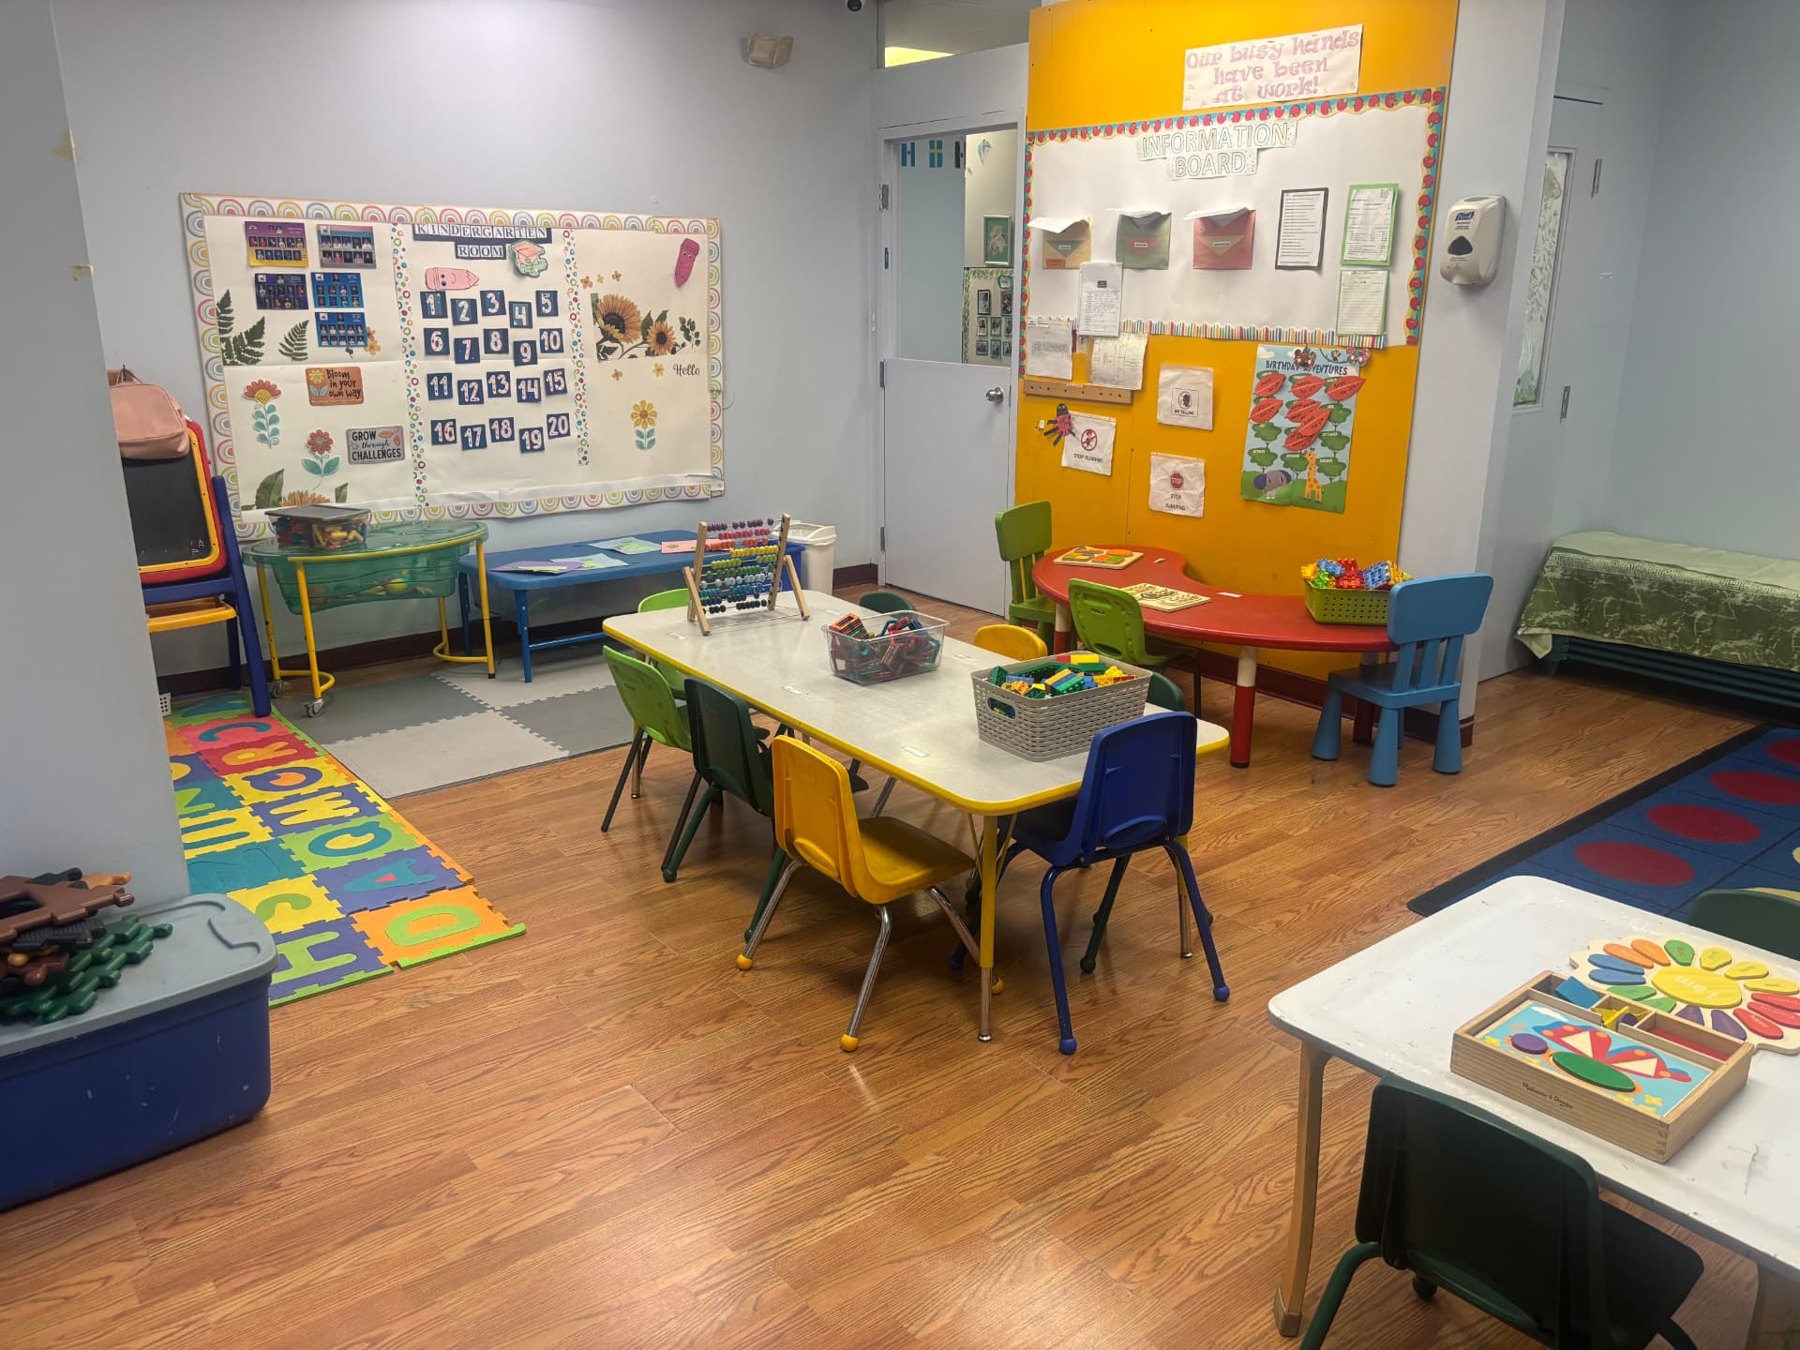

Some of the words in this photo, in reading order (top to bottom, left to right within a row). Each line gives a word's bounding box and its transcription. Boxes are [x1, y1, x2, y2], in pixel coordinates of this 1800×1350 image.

[1185, 50, 1223, 69] Our
[1230, 41, 1284, 64] busy
[1292, 29, 1360, 55] hands
[1213, 64, 1264, 85] have
[1274, 56, 1329, 78] been
[1215, 85, 1243, 104] at
[1257, 78, 1319, 100] work!
[1142, 123, 1288, 157] INFORMATION
[1175, 152, 1246, 177] BOARD
[417, 224, 547, 238] KINDERGARTEN
[459, 245, 503, 258] ROOM
[427, 295, 435, 315] 1
[459, 301, 470, 322] 2
[486, 293, 499, 313] 3
[514, 306, 527, 326] 4
[542, 294, 551, 313] 5
[431, 331, 444, 351] 6
[463, 340, 471, 360] 7
[491, 332, 502, 351] 8
[520, 343, 531, 362] 9
[541, 331, 560, 350] 10
[327, 370, 349, 379] Bloom
[673, 363, 699, 375] Hello
[340, 381, 356, 390] your
[346, 390, 360, 399] way
[430, 376, 448, 396] 11
[461, 382, 479, 402] 12
[489, 375, 509, 395] 13
[518, 380, 538, 399] 14
[546, 371, 565, 392] 15
[352, 431, 376, 441] GROW
[435, 422, 455, 442] 16
[465, 428, 482, 448] 17
[492, 420, 512, 440] 18
[523, 430, 542, 450] 19
[548, 416, 568, 435] 20
[361, 440, 390, 449] through
[352, 448, 401, 461] CHALLENGES
